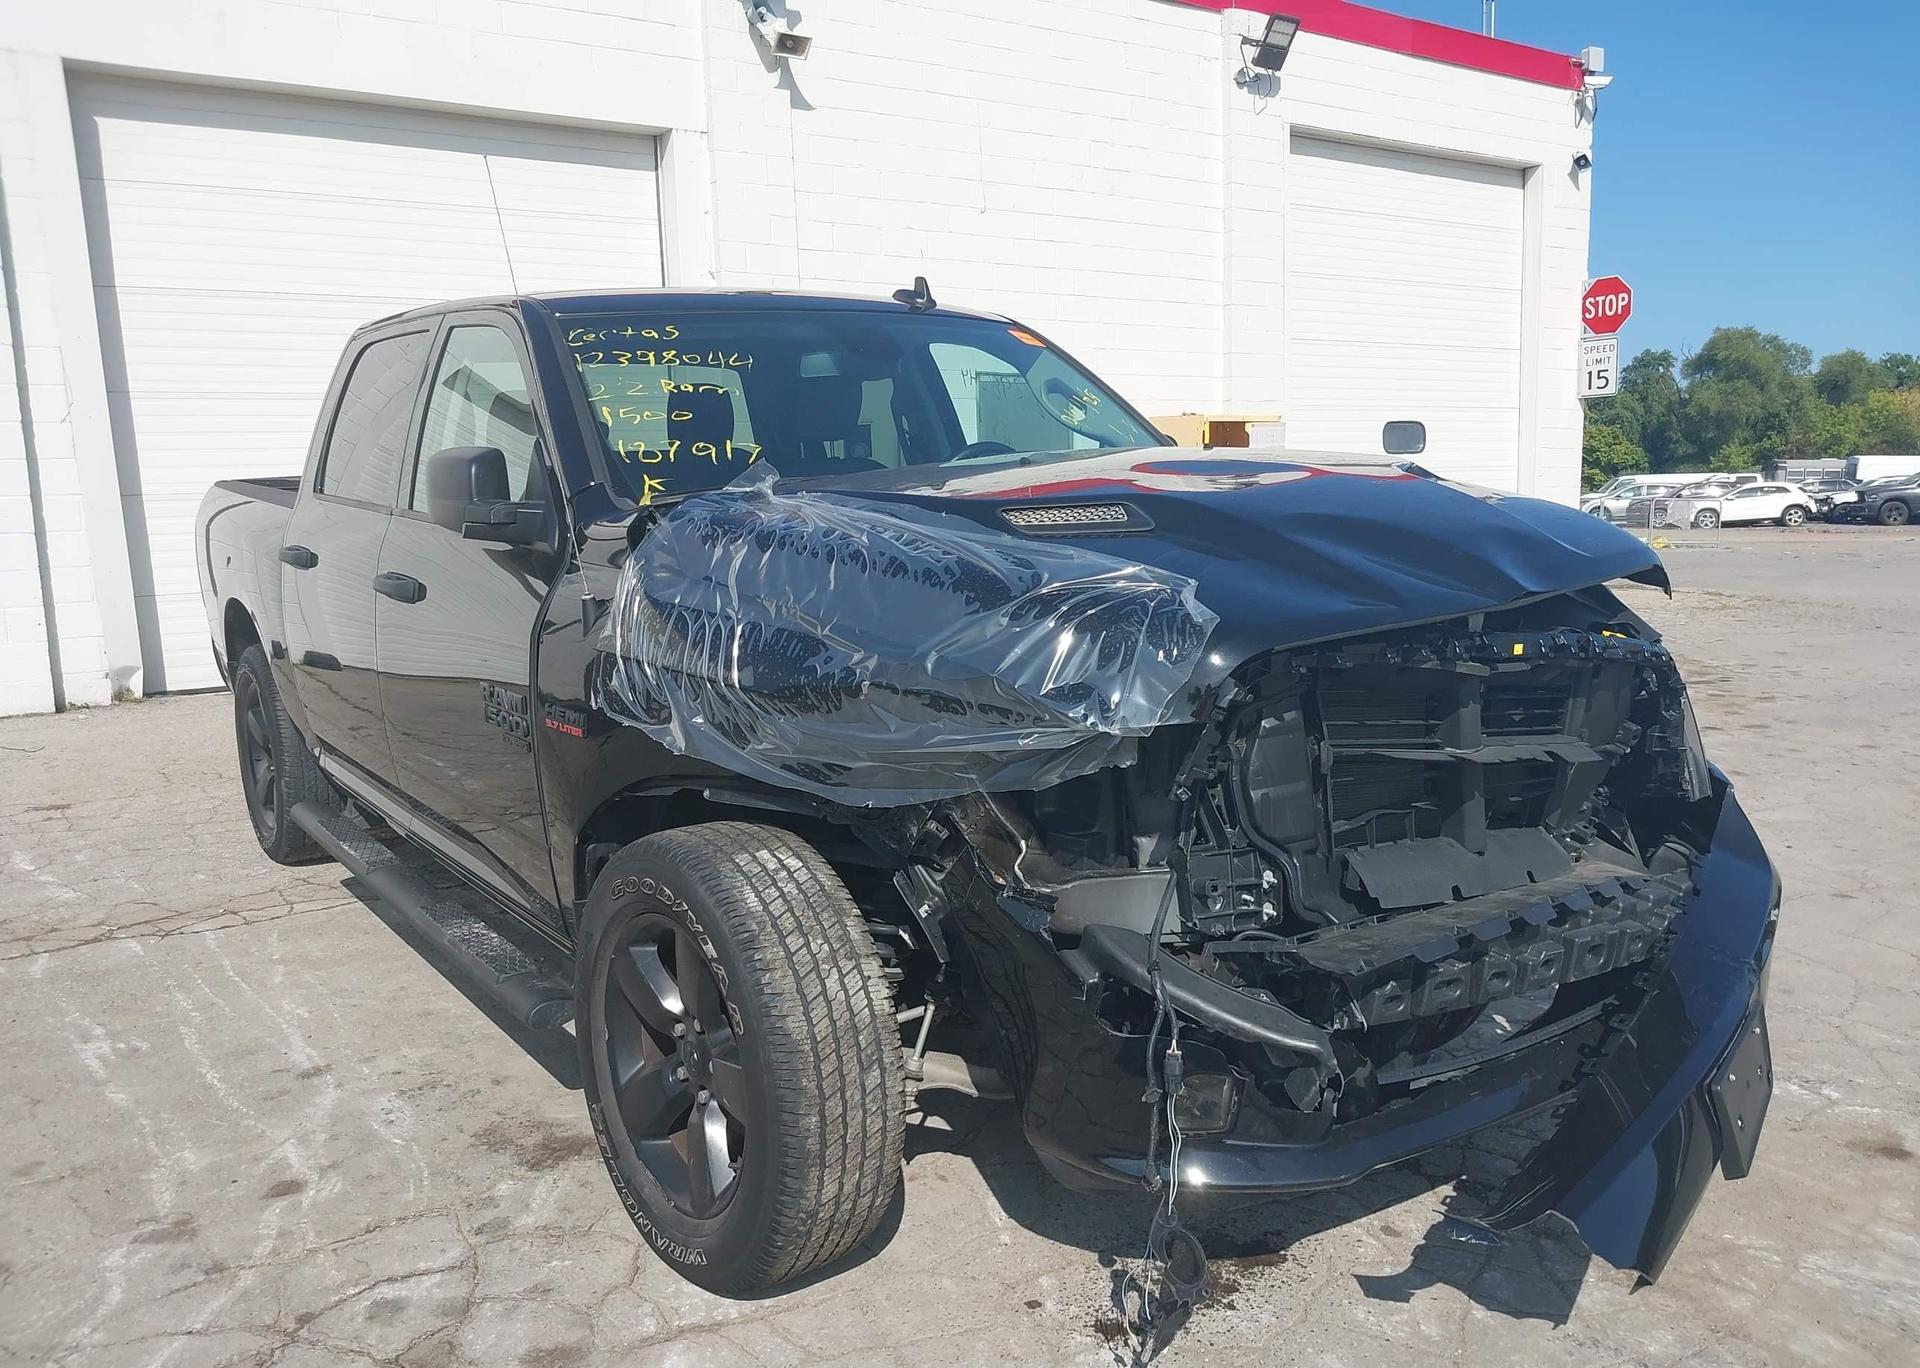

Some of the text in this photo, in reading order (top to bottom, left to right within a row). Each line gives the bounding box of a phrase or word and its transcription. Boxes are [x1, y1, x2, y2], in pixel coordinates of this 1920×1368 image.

[1585, 292, 1629, 319] STOP
[1583, 343, 1615, 355] SPEED
[1585, 356, 1612, 367] LIMIT
[1587, 369, 1610, 391] 15
[602, 405, 693, 427] 1500
[480, 681, 528, 716] RAM
[544, 703, 588, 738] HEMI
[544, 717, 584, 738] 5.7 LITER
[610, 876, 745, 1036] GOODYEAR
